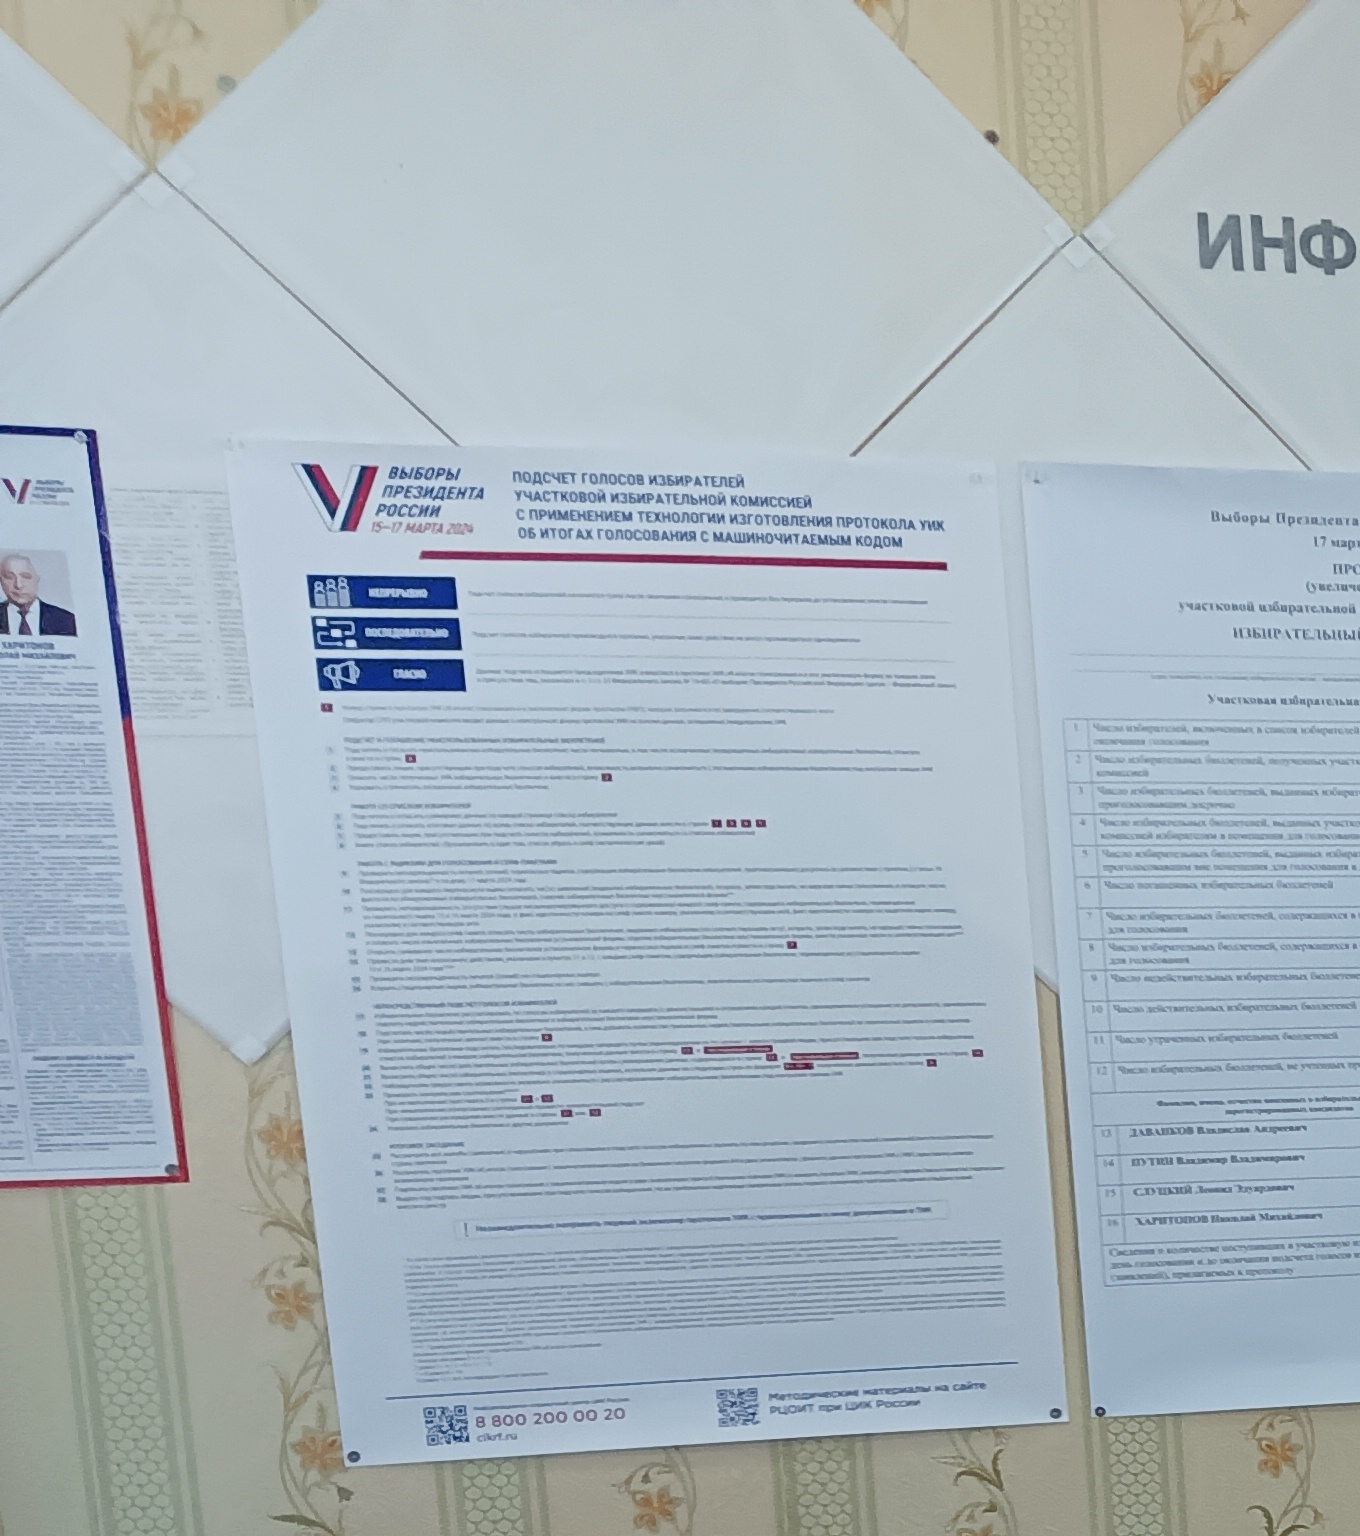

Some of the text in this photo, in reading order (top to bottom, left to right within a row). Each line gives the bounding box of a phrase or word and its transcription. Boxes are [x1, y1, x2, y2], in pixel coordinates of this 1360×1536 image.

[388, 466, 461, 481] ВЫБОРЫ
[512, 471, 745, 489] ПОДСЧЕТ ГОЛОСОВ ИЗБИРАТЕЛЕЙ
[382, 485, 485, 501] ПРЕЗИДЕНТА
[515, 489, 813, 510] УЧАСТКОВОЙ ИЗБИРАТЕЛЬНОЙ КОМИССИЕЙ
[375, 504, 442, 518] РОССИИ
[1210, 510, 1270, 525] Выборы
[1275, 512, 1359, 528] Президента
[404, 523, 443, 534] МАРТА
[446, 523, 474, 535] 2024
[516, 510, 526, 521] С
[529, 510, 633, 523] ПРИМЕНЕНИЕМ
[637, 511, 726, 525] ТЕХНОЛОГИИ
[729, 514, 833, 528] ИЗГОТОВЛЕНИЯ
[836, 517, 916, 531] ПРОТОКОЛА
[518, 528, 903, 549] ОБ ИТОГАХ ГОЛОСОВАНИЯ С МАШИНОЧИТАЕМЫМ КОДОМ
[1312, 535, 1327, 547] 17
[1258, 602, 1357, 617] избирательной
[768, 1381, 987, 1401] Методические материалы на сайте
[475, 1408, 626, 1428] 8 800 200 00 20
